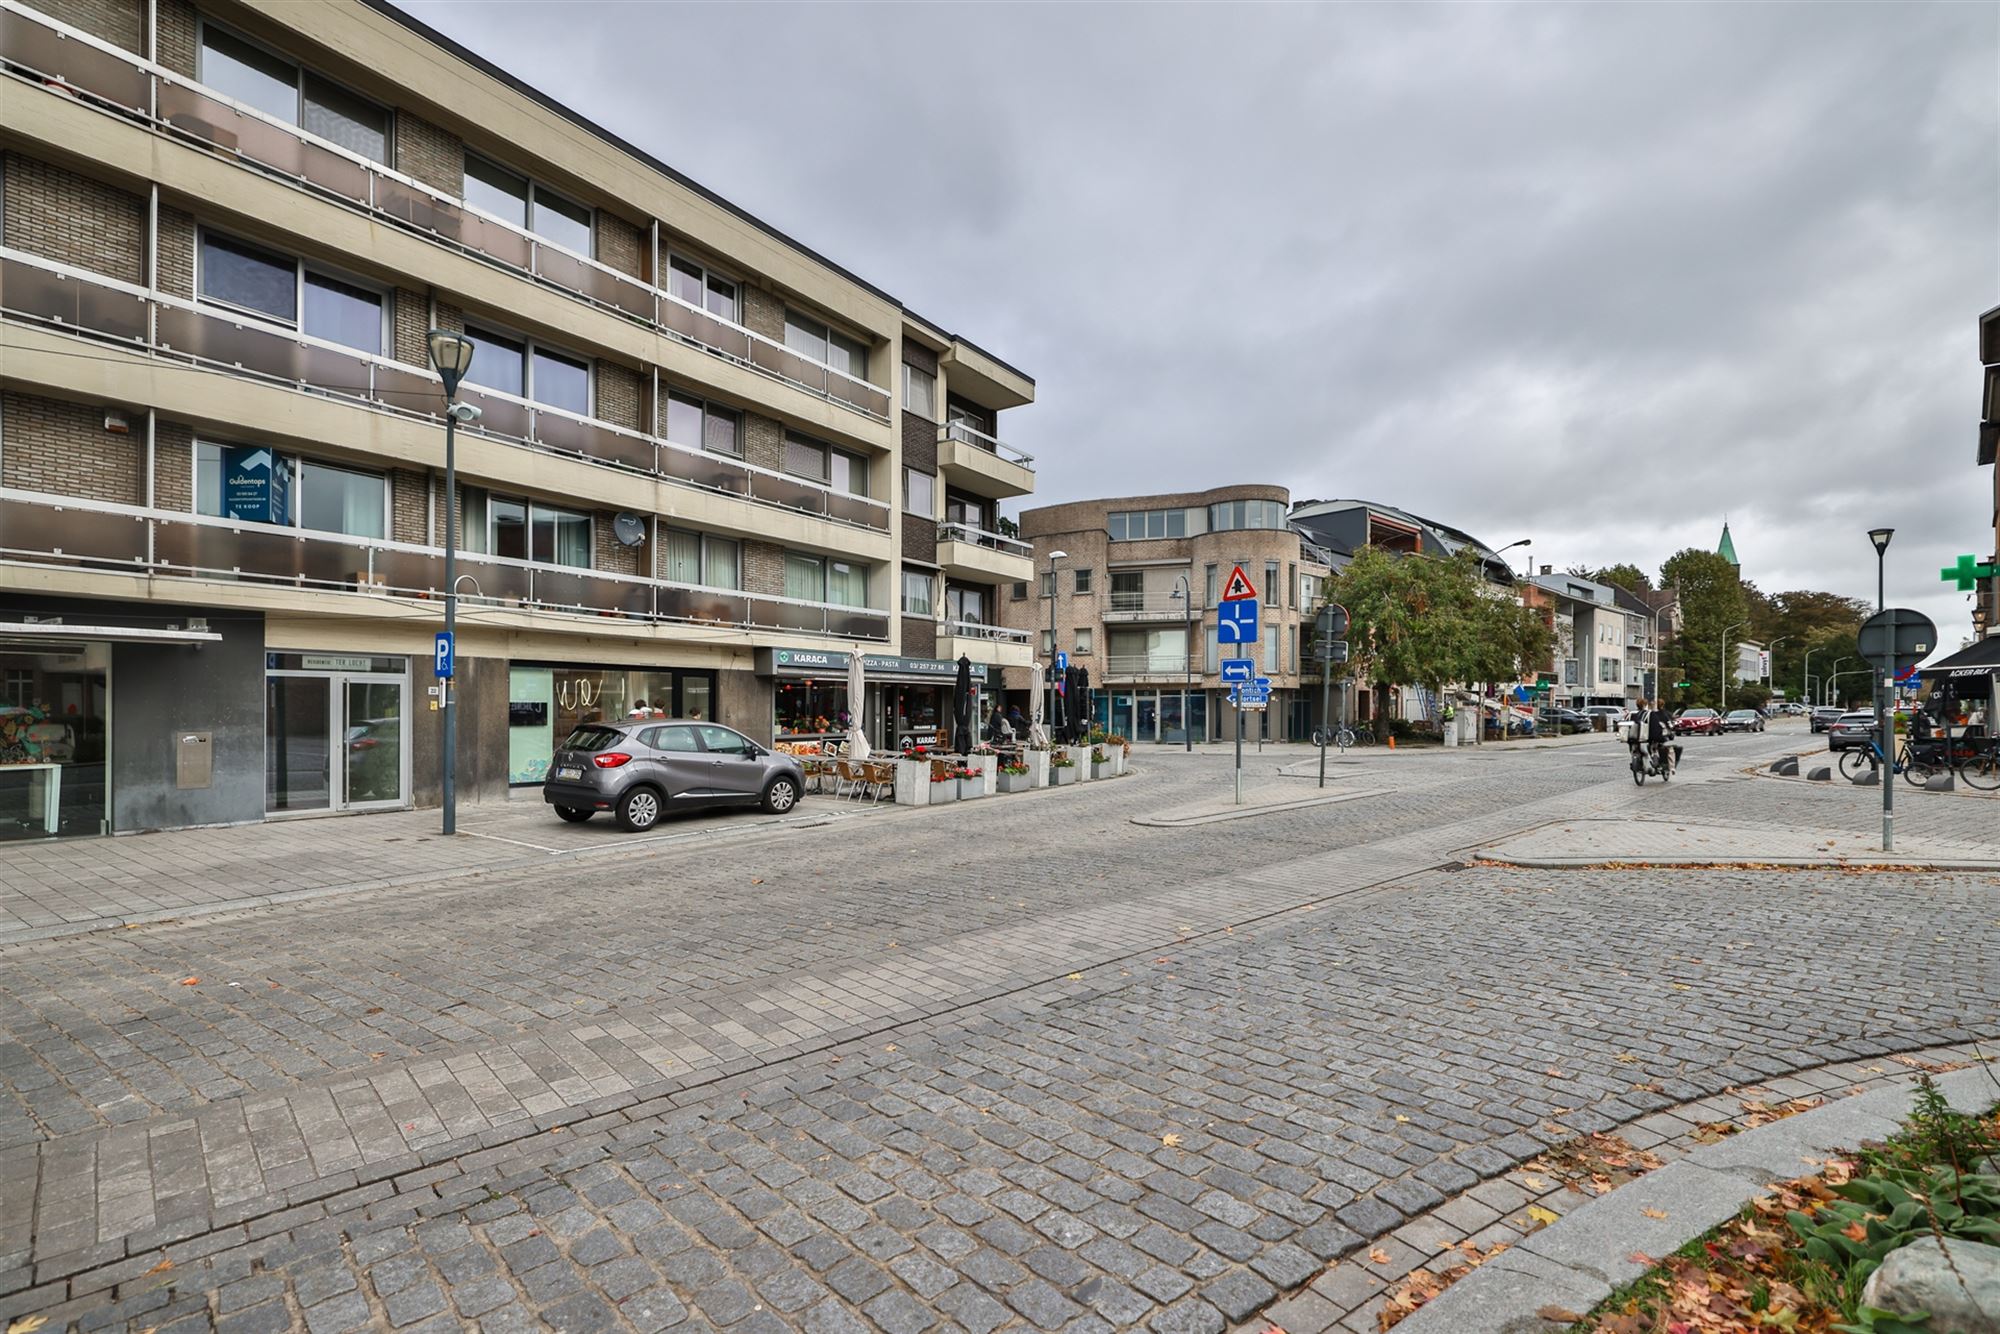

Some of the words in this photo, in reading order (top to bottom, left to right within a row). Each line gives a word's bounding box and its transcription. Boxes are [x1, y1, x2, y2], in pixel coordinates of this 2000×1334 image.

[437, 639, 449, 671] P
[794, 654, 828, 664] KARACA
[863, 659, 878, 667] IZZA
[881, 660, 899, 668] PASTA
[916, 736, 938, 745] KARAC
